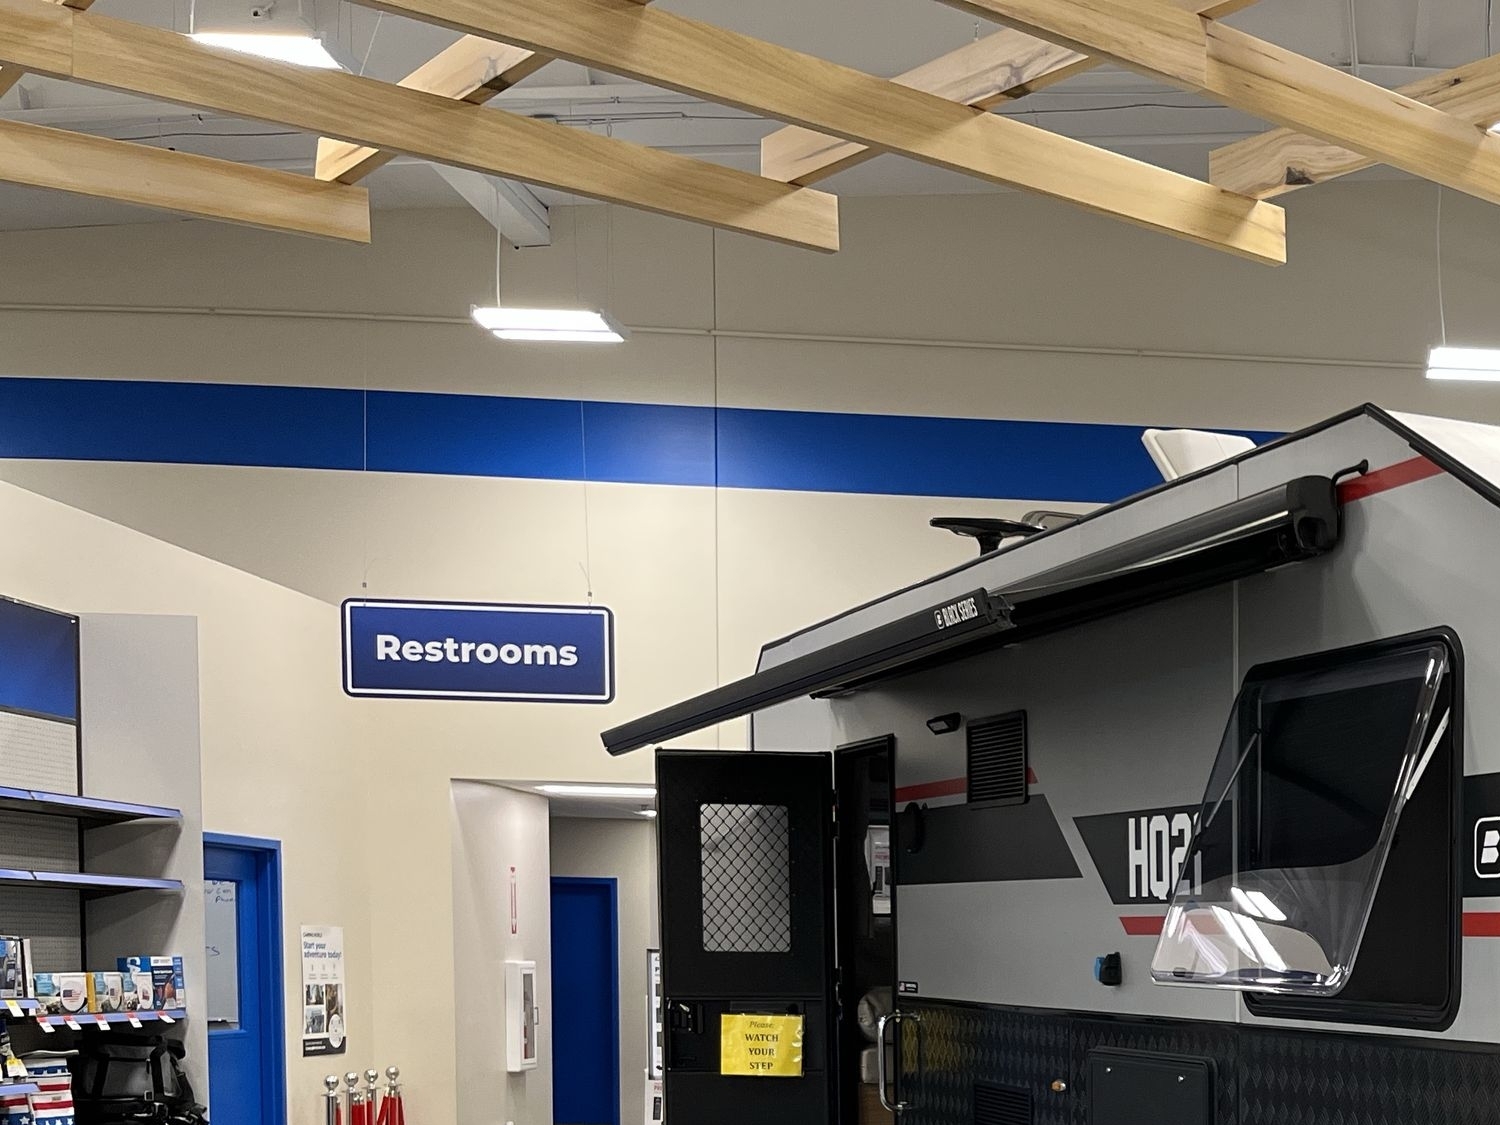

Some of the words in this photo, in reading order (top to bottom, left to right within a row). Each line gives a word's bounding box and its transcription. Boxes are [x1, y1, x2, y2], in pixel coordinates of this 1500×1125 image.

[376, 633, 579, 667] Restrooms
[745, 1033, 779, 1042] WATCH
[749, 1047, 775, 1056] YOUR
[749, 1062, 774, 1070] STEP
